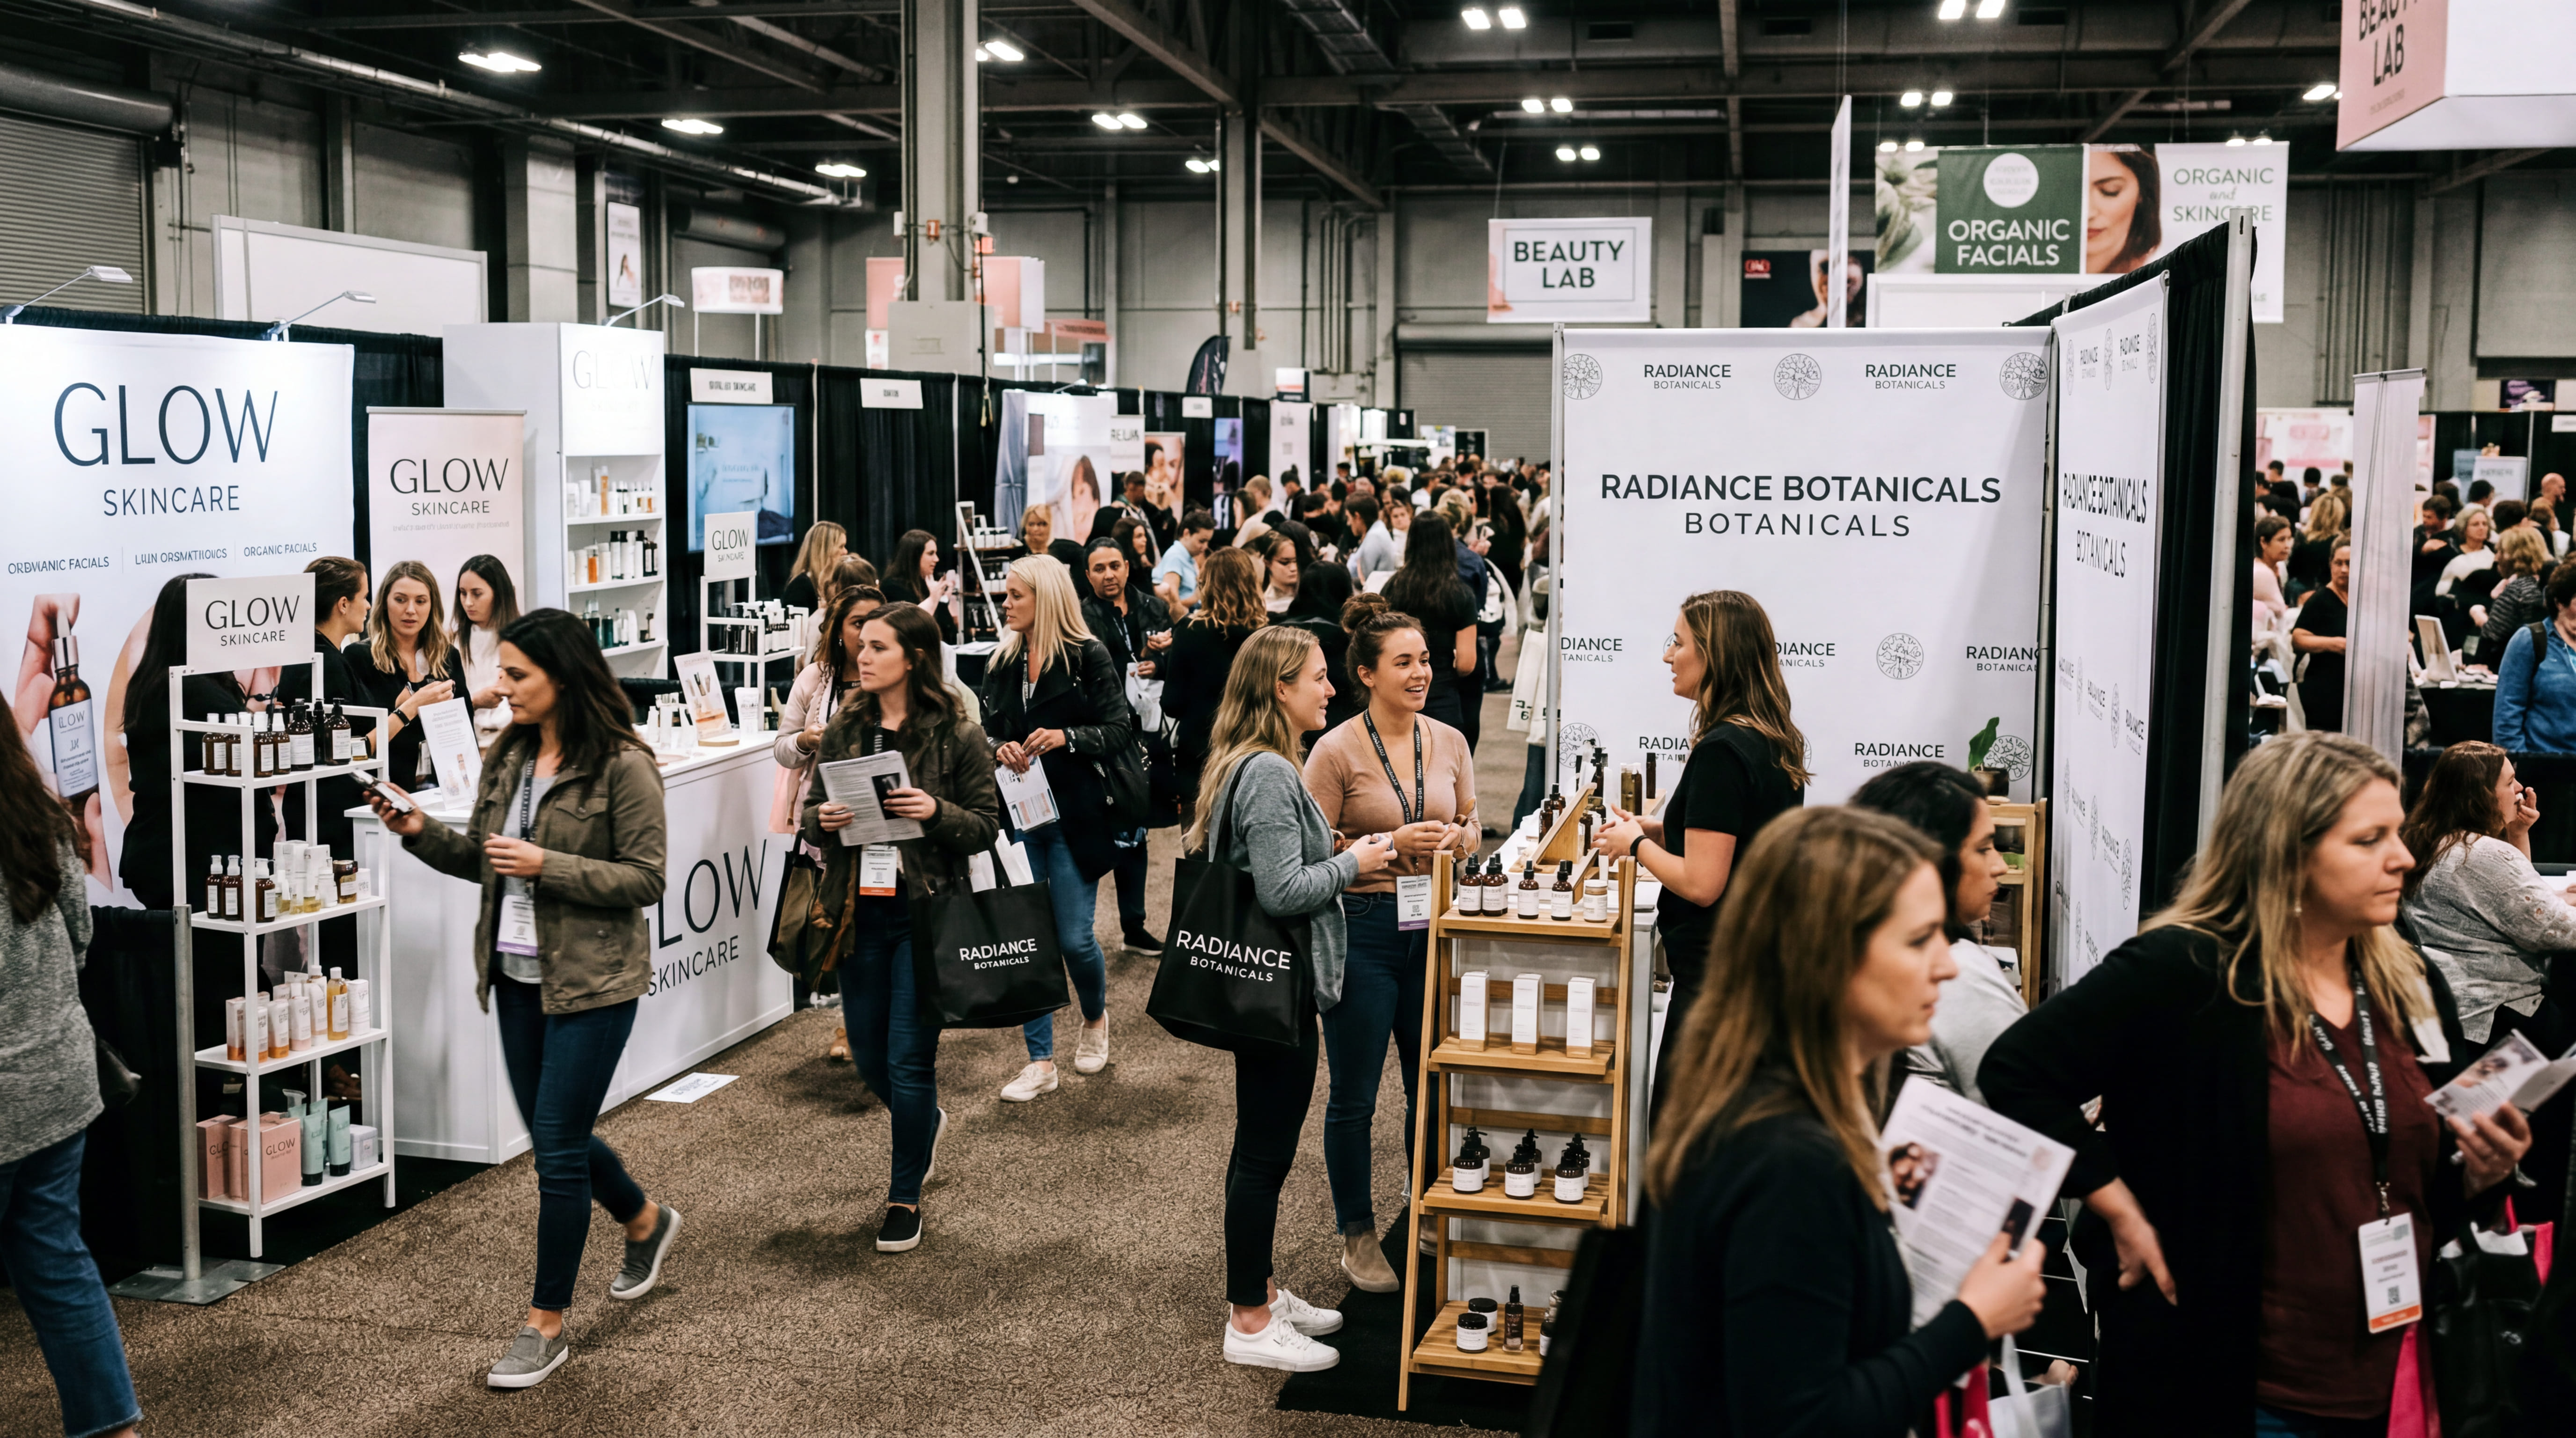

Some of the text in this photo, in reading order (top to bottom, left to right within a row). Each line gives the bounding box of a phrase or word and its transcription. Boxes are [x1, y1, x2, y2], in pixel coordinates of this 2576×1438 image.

[2374, 23, 2404, 87] LAB
[2174, 168, 2273, 185] ORGANIC
[2174, 205, 2273, 222] SKINCRE
[1948, 219, 2070, 241] ORGANIC
[1514, 240, 1625, 262] BEAUTY
[1958, 244, 2059, 266] FACIALS
[1543, 267, 1595, 289] LAB
[1645, 365, 1731, 377] RADIANCE
[1866, 364, 1956, 378] RADIANCE
[55, 383, 277, 466] GLOW
[390, 458, 508, 493] GLOW
[1602, 475, 2000, 503] RADIANCE BOTANICALS
[2063, 473, 2147, 524] RADIANCE BOTANICALS
[104, 486, 239, 516] SKINCARE
[412, 501, 490, 515] SKINCARE
[1686, 513, 1909, 536] BOTANICALS
[712, 528, 749, 550] GLOW
[244, 544, 283, 557] ORGANIC
[2077, 529, 2126, 578] BOTANICALS
[69, 556, 110, 570] FACIALS
[205, 595, 300, 630] GLOW
[220, 630, 285, 646] SKINCARE
[1561, 637, 1623, 651] DIANCE
[1562, 653, 1613, 662] TANICALS
[1967, 646, 2038, 660] RADIAN
[1639, 736, 1690, 750] RADIA
[1855, 743, 1944, 757] RADIANCE
[645, 839, 767, 949] LOW
[959, 939, 1037, 961] RADIANCE
[1176, 930, 1292, 970] RADIANCE
[974, 956, 1030, 970] BOTANICALS
[1190, 956, 1273, 982] BOTANICALS
[266, 1138, 295, 1155] GLOW
